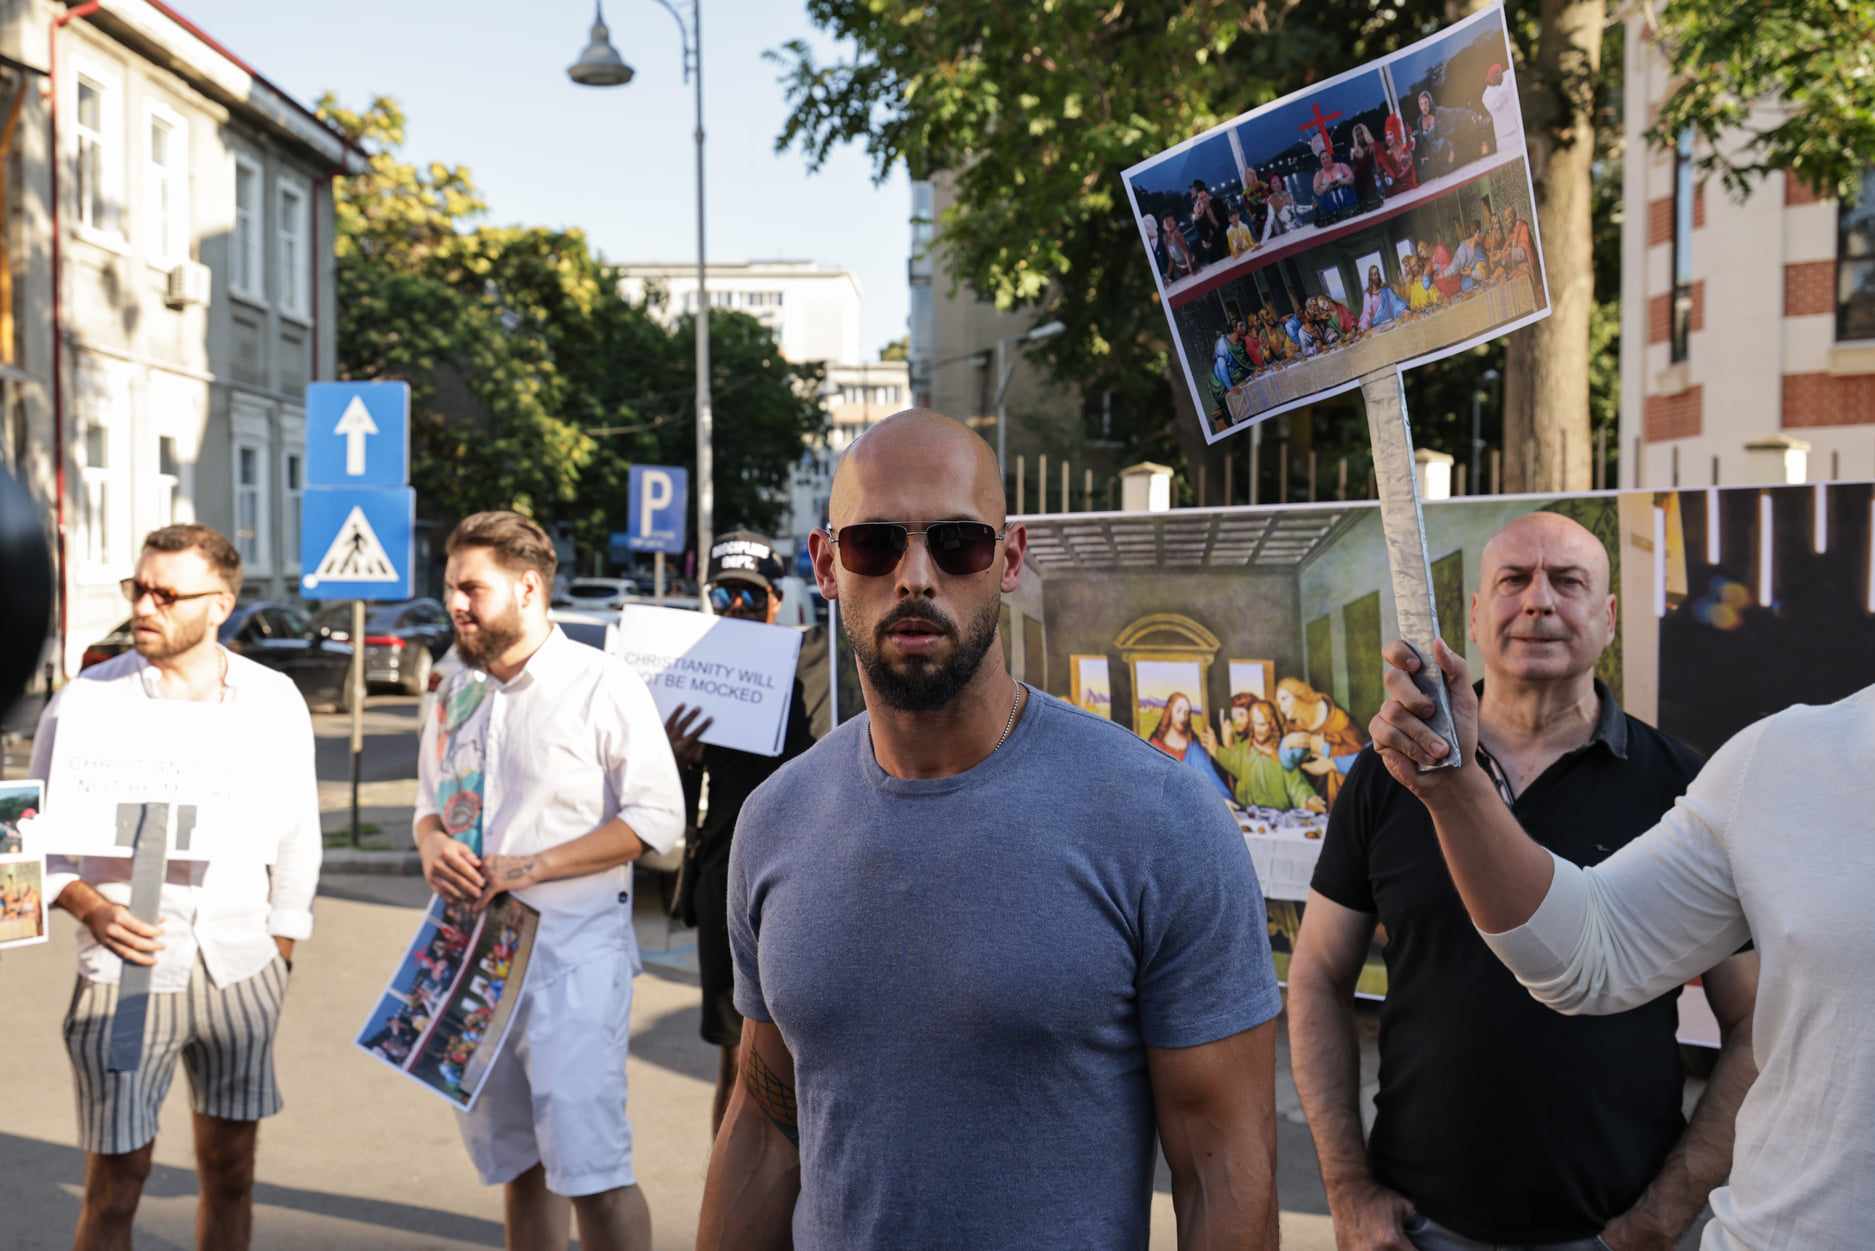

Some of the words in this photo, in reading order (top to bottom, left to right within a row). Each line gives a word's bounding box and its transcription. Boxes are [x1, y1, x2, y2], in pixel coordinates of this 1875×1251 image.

[641, 469, 672, 537] P
[624, 651, 735, 678] CHRISTIANITY
[738, 669, 775, 689] WILL
[665, 673, 688, 689] BE
[690, 677, 763, 704] MOCKED
